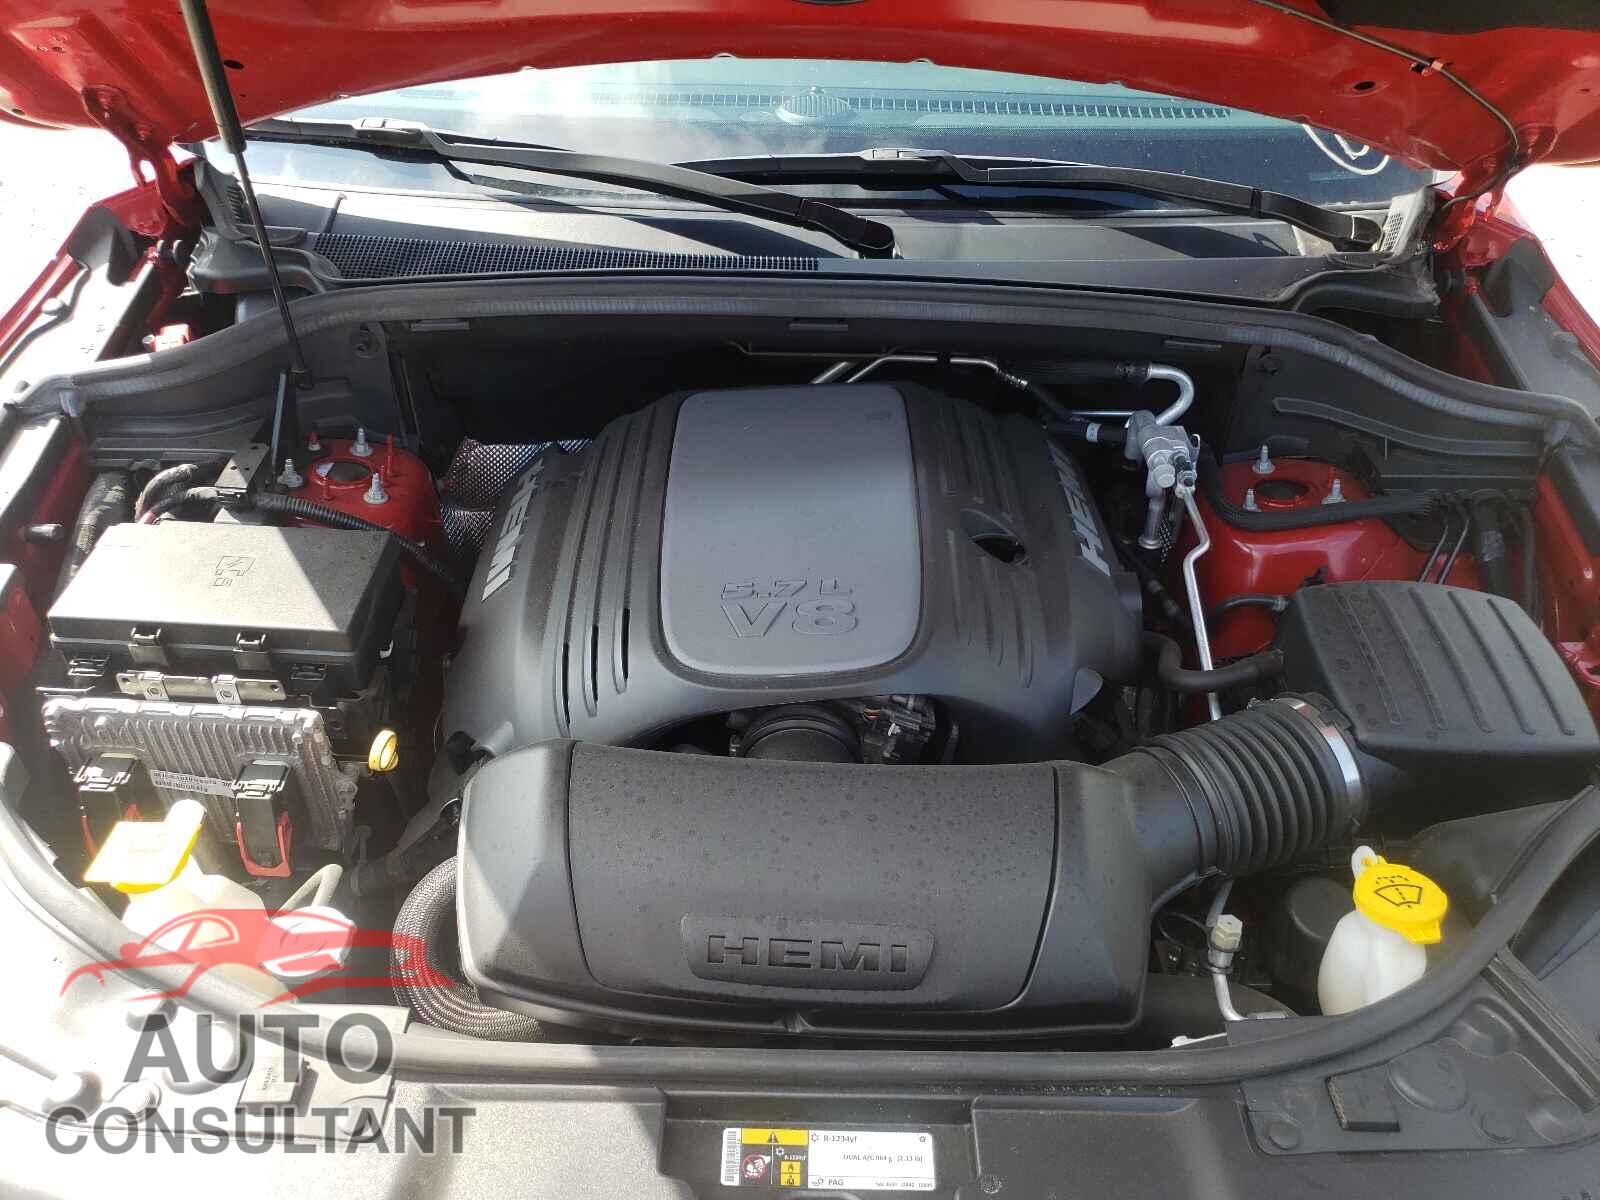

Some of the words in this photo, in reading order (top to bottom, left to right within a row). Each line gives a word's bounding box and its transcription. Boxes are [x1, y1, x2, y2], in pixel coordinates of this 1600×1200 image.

[1046, 440, 1112, 576] HEMI
[481, 457, 544, 602] HEMI
[720, 601, 858, 638] V8
[707, 935, 908, 972] HEMI
[823, 1134, 857, 1144] R-1234yf
[828, 1178, 844, 1186] PAG
